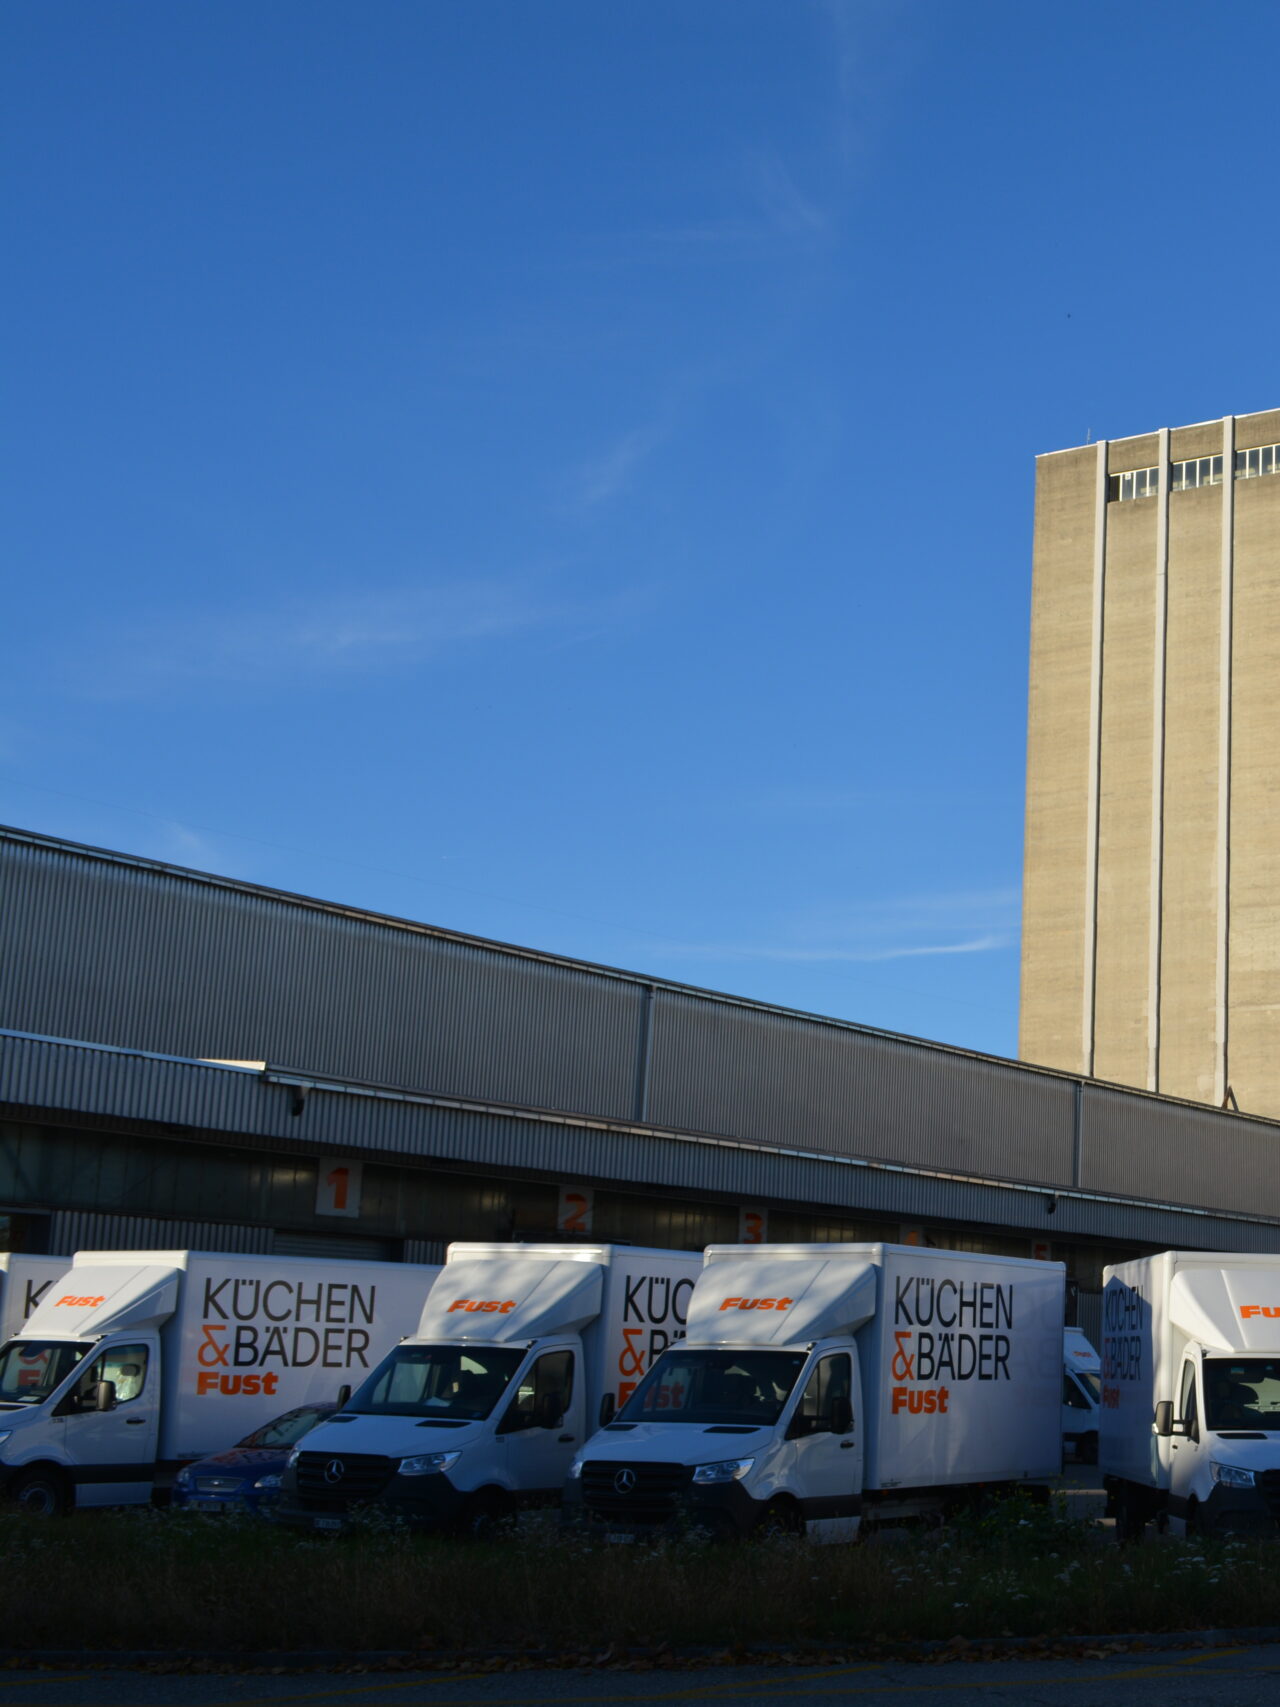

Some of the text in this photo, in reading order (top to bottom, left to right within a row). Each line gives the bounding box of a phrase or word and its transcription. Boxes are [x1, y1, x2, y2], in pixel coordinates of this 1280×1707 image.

[327, 1168, 348, 1209] 1
[564, 1194, 586, 1232] 2
[744, 1213, 763, 1244] 3
[54, 1296, 106, 1307] Fust
[203, 1278, 376, 1324] KÜCHEN
[447, 1299, 517, 1313] Fust
[624, 1275, 695, 1325] KÜC
[719, 1297, 793, 1311] Fust
[895, 1276, 1013, 1329] KÜCHEN
[1104, 1285, 1144, 1331] KÜCHEN
[197, 1372, 278, 1395] Fust
[1103, 1384, 1120, 1409] Fust
[892, 1386, 949, 1414] Fust
